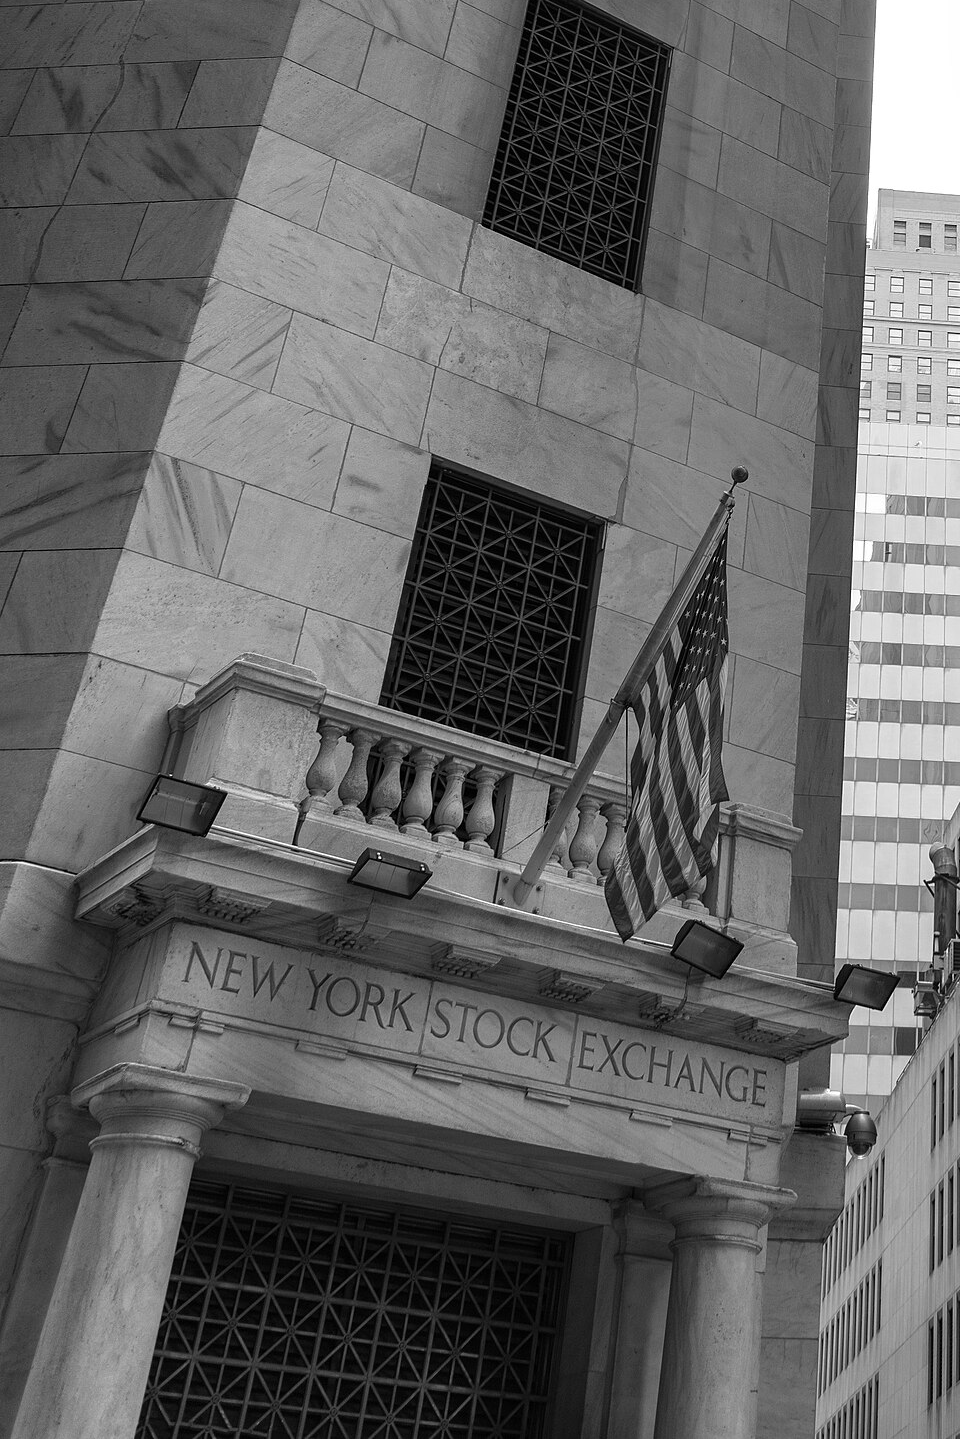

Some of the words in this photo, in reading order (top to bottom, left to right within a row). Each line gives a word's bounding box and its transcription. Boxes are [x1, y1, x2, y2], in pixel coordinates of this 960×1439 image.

[180, 940, 295, 1002] NEW
[305, 967, 417, 1032] YORK
[430, 998, 558, 1063] STOCK
[576, 1030, 768, 1108] EXCHANGE
